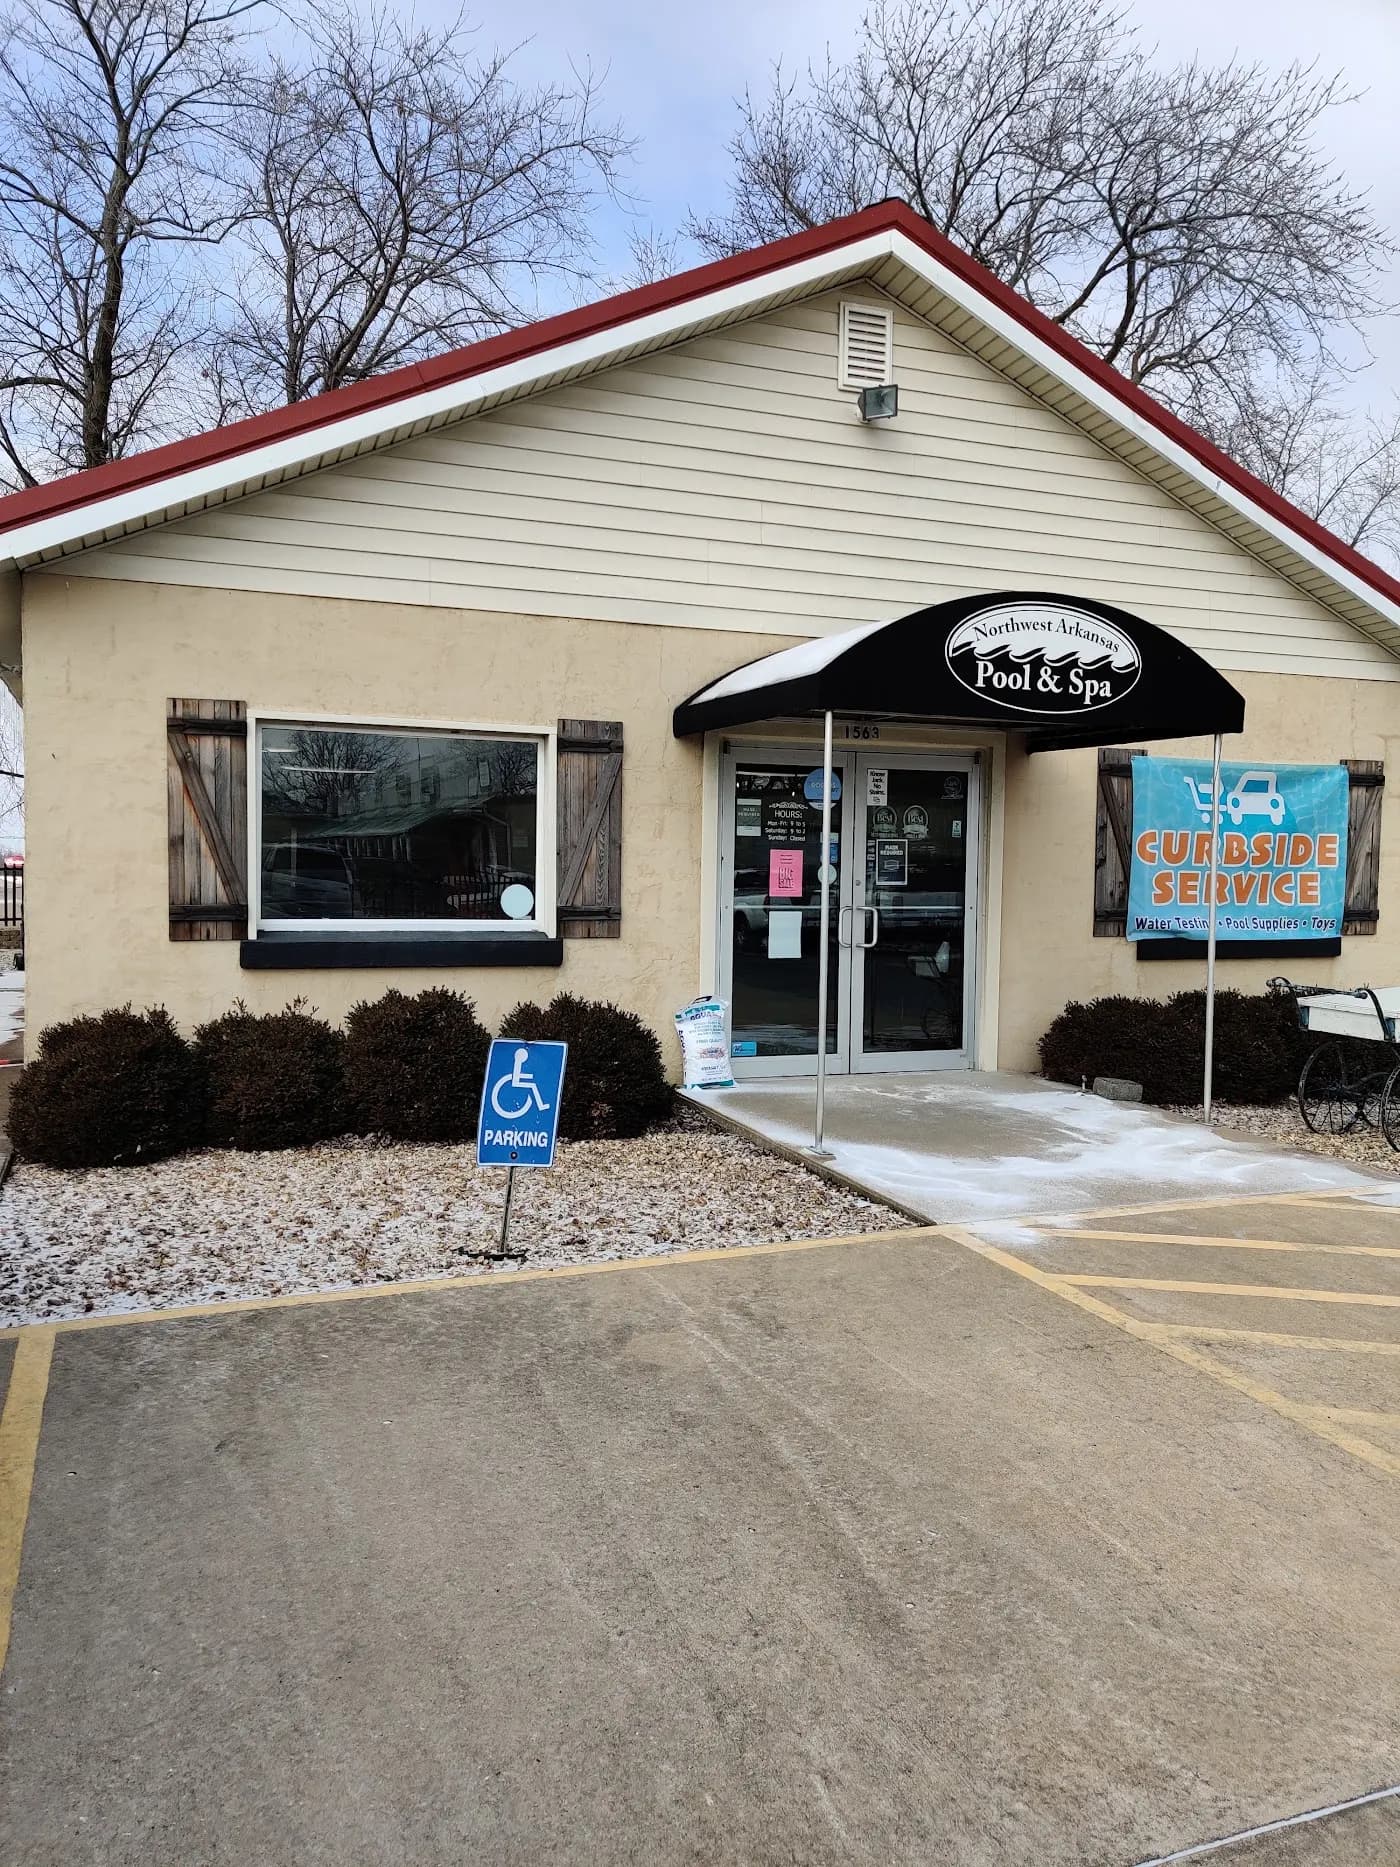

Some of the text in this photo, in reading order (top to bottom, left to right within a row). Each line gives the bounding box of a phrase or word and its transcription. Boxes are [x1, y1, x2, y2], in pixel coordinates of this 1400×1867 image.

[973, 616, 1120, 653] Northwest Arkansas
[975, 660, 1112, 705] Pool & Spa
[845, 725, 880, 739] 1563
[774, 809, 803, 819] HOURS:
[1135, 830, 1339, 868] CURBSIDE
[1152, 870, 1321, 907] SERVICE
[1136, 917, 1336, 932] Water Testin Pool Supplies Toys
[483, 1129, 549, 1148] PARKING
